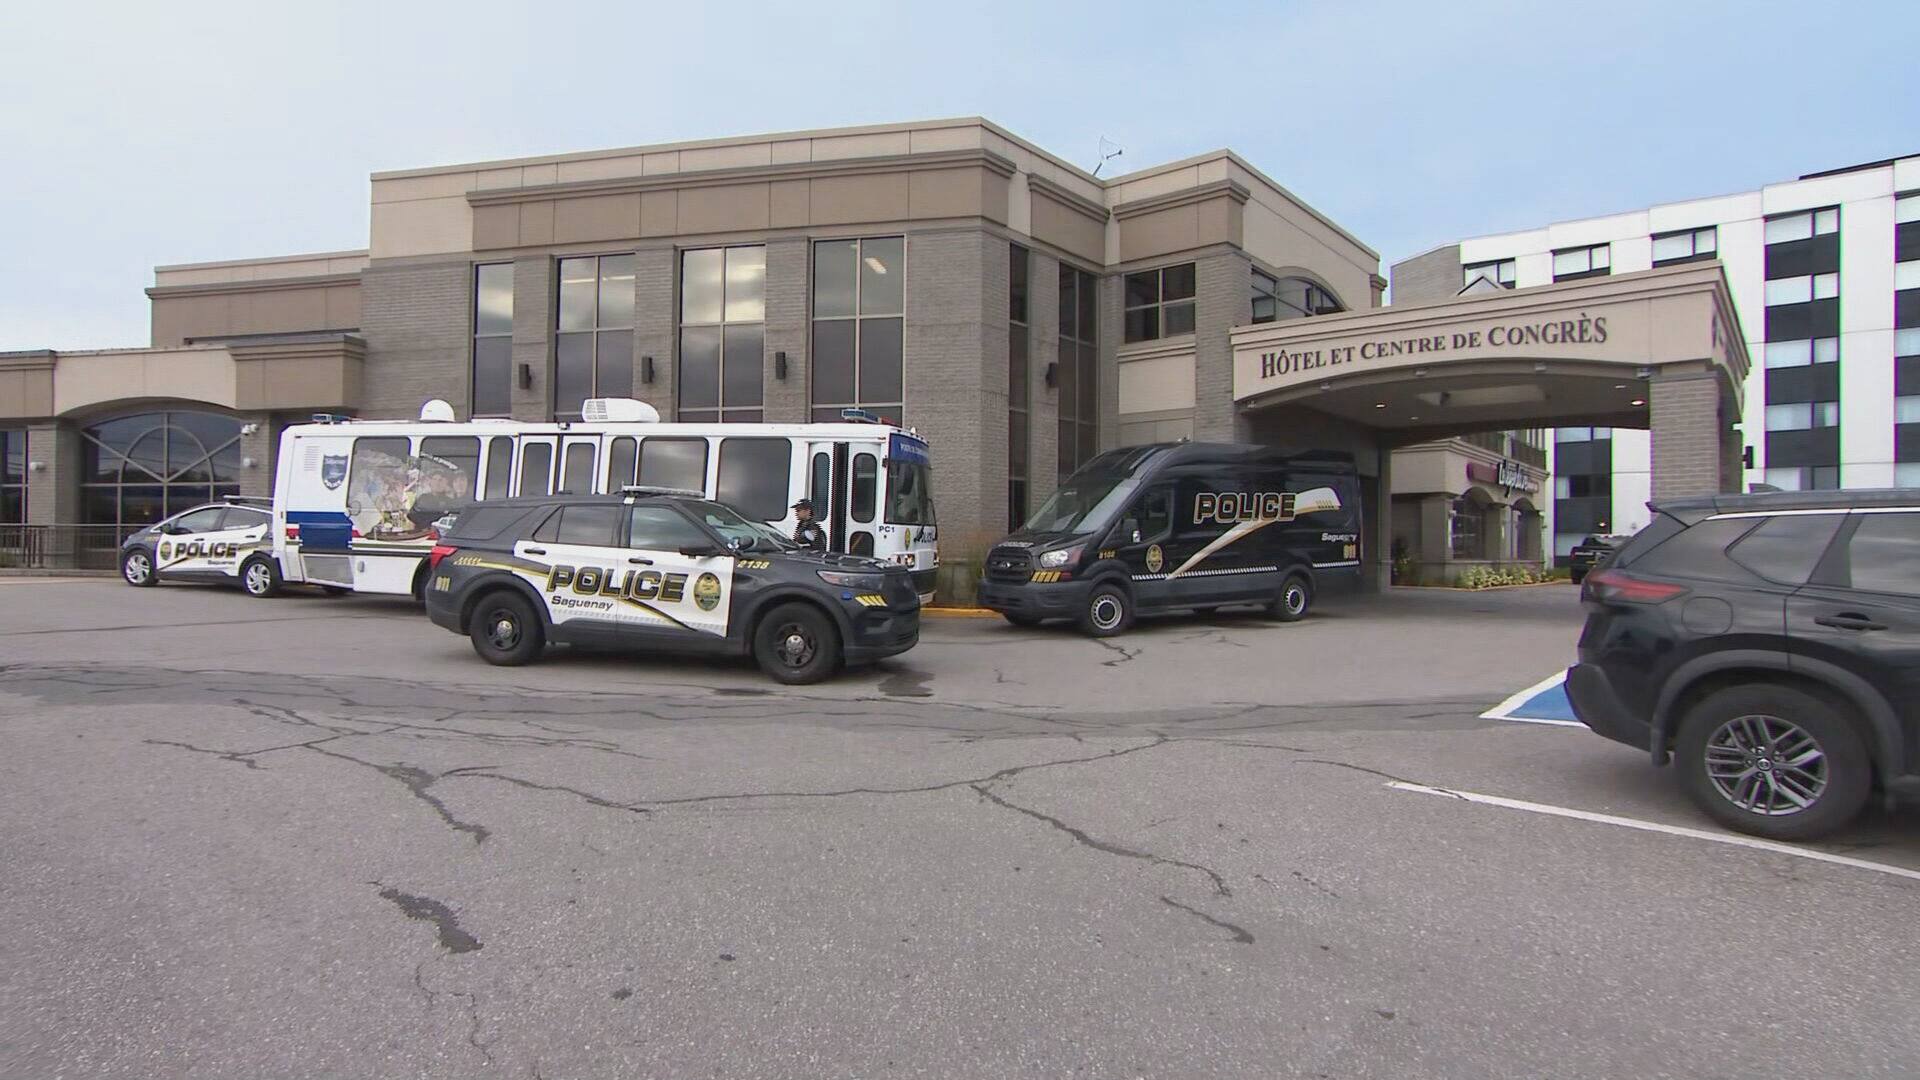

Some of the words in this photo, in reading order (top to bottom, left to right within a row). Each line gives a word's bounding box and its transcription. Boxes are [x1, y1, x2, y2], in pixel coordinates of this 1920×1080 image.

[1261, 349, 1327, 379] HÔTEL
[1330, 346, 1356, 365] ET
[1359, 335, 1446, 360] CENTRE
[1452, 331, 1481, 350] DE
[1488, 312, 1607, 346] CONGRÈS
[1193, 492, 1297, 525] POLICE
[174, 542, 239, 559] POLICE
[545, 564, 689, 603] POLICE
[550, 595, 614, 612] Saguenay
